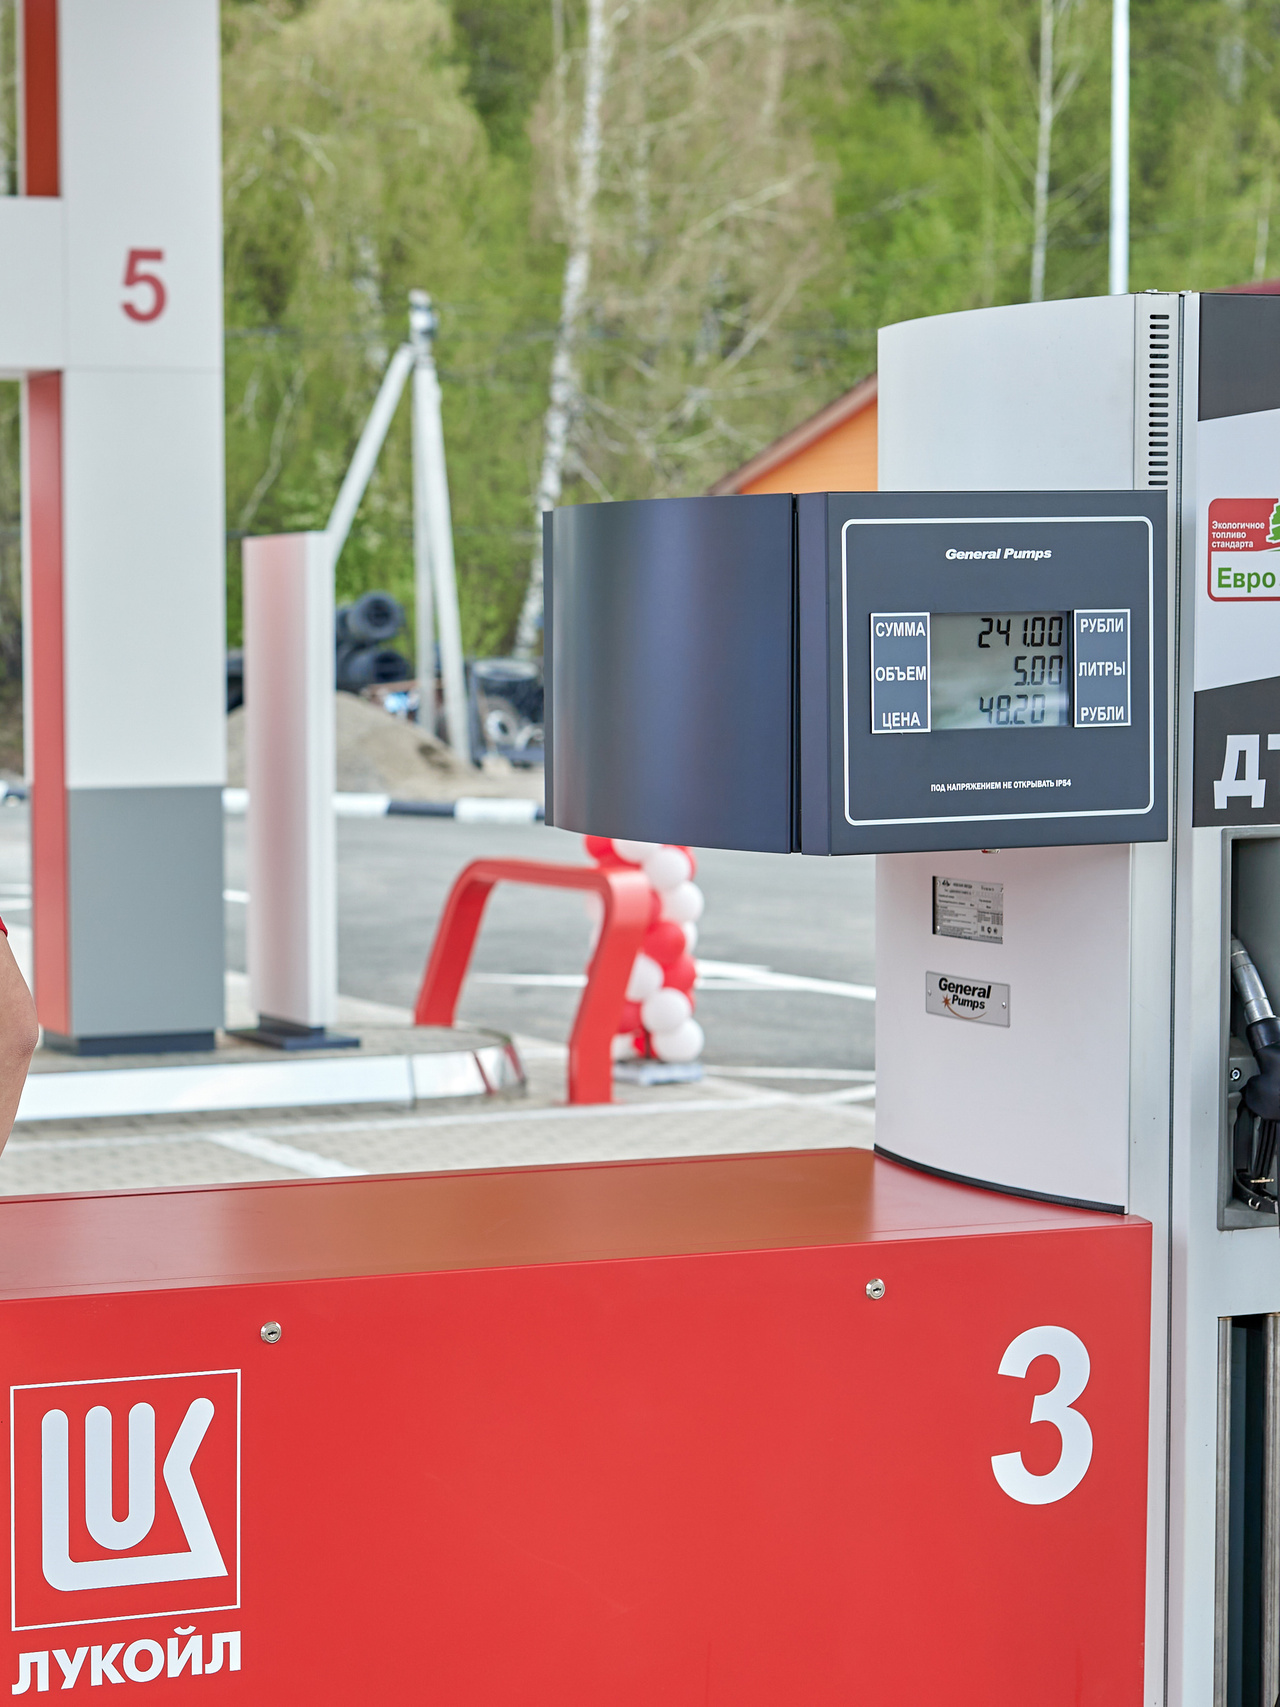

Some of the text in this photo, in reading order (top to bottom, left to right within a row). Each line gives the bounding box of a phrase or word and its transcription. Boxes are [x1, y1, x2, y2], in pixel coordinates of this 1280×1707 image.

[122, 249, 167, 322] 5
[1212, 521, 1265, 530] Экологичное
[1212, 541, 1254, 549] стандарта
[945, 548, 1052, 561] General Pumps
[1217, 567, 1276, 593] Евро
[875, 622, 926, 637] СУММА
[978, 617, 1063, 648] 241.00
[1080, 618, 1124, 633] РУБЛИ
[875, 666, 927, 682] ОБЪЕМ
[1014, 655, 1063, 686] 5.00
[1078, 662, 1126, 677] ЛИТРЫ
[979, 694, 1046, 725] 48.20
[1080, 706, 1125, 721] РУБЛИ
[882, 712, 921, 729] ЦЕНА
[930, 779, 1071, 792] ПОД НАПРЯЖЕНИЕМ НЕ ОТКРЫВАТЬ IP54
[938, 977, 991, 999] General
[952, 995, 985, 1011] Pumps
[991, 1326, 1093, 1505] 3
[41, 1397, 228, 1592] LUK
[12, 1625, 242, 1695] ЛУКОЙЛ
